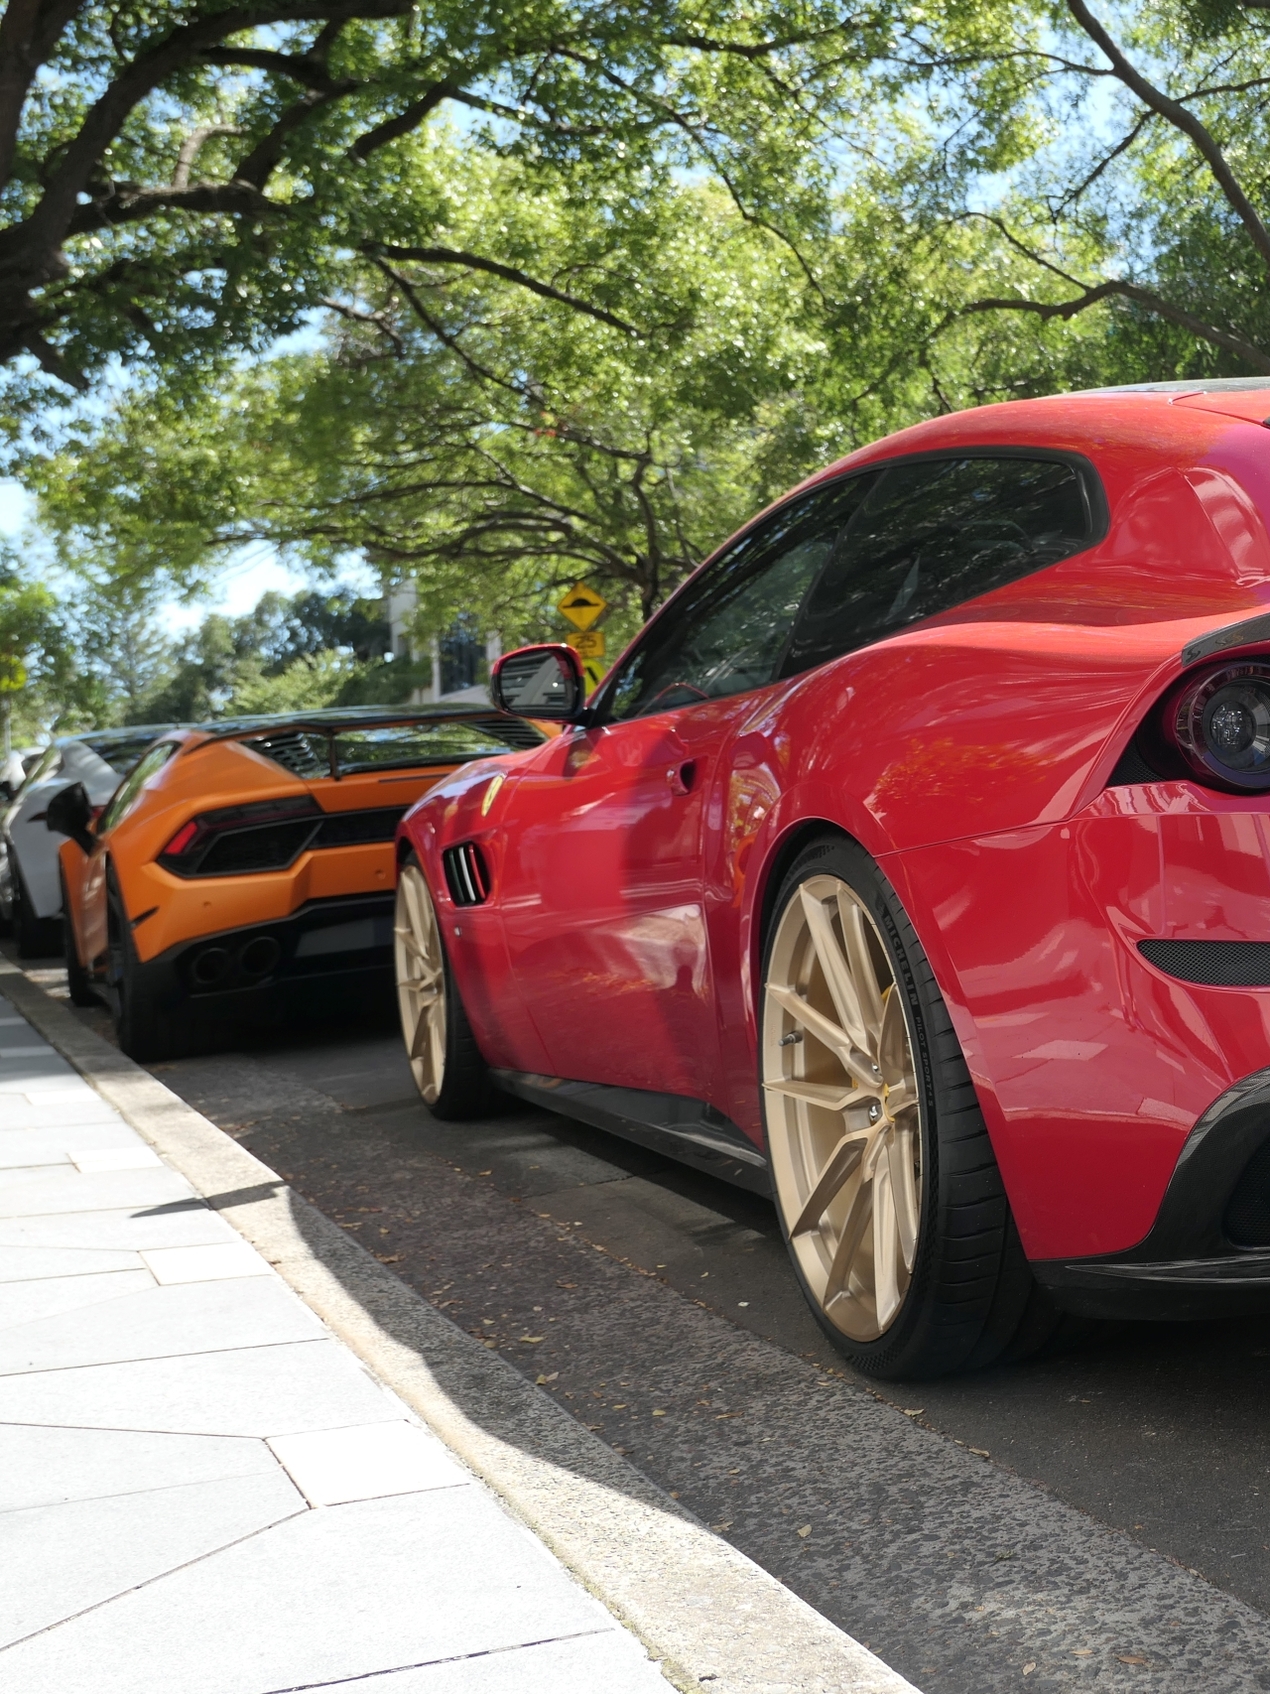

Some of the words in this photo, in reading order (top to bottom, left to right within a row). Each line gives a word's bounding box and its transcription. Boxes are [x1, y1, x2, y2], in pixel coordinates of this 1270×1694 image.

[575, 635, 597, 649] 25
[883, 915, 919, 1007] MICHELIN
[915, 1016, 927, 1048] PILOT
[921, 1051, 933, 1090] SPORT
